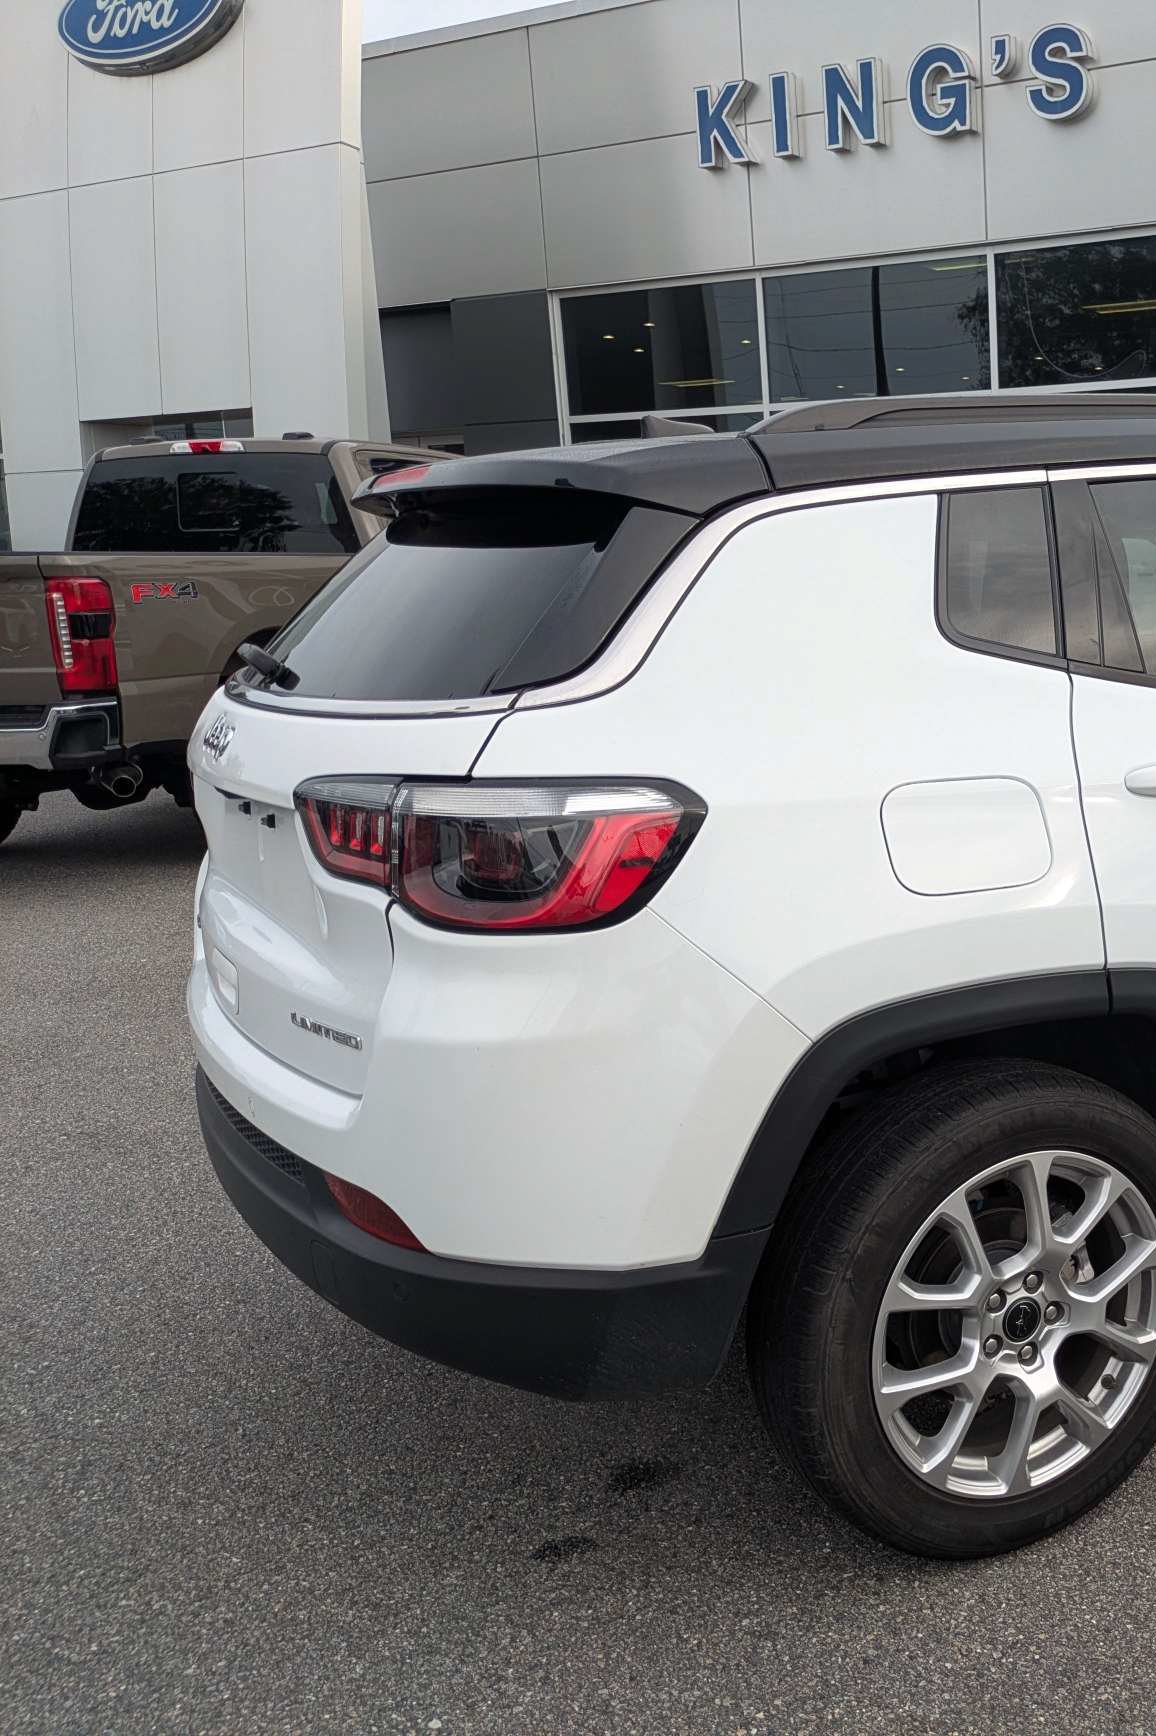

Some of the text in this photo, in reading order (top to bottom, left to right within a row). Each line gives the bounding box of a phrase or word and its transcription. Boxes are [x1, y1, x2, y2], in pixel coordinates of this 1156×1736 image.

[87, 0, 179, 43] Ford
[693, 22, 1095, 170] KING'S
[130, 582, 199, 604] FX4
[290, 1010, 362, 1050] LIMITED
